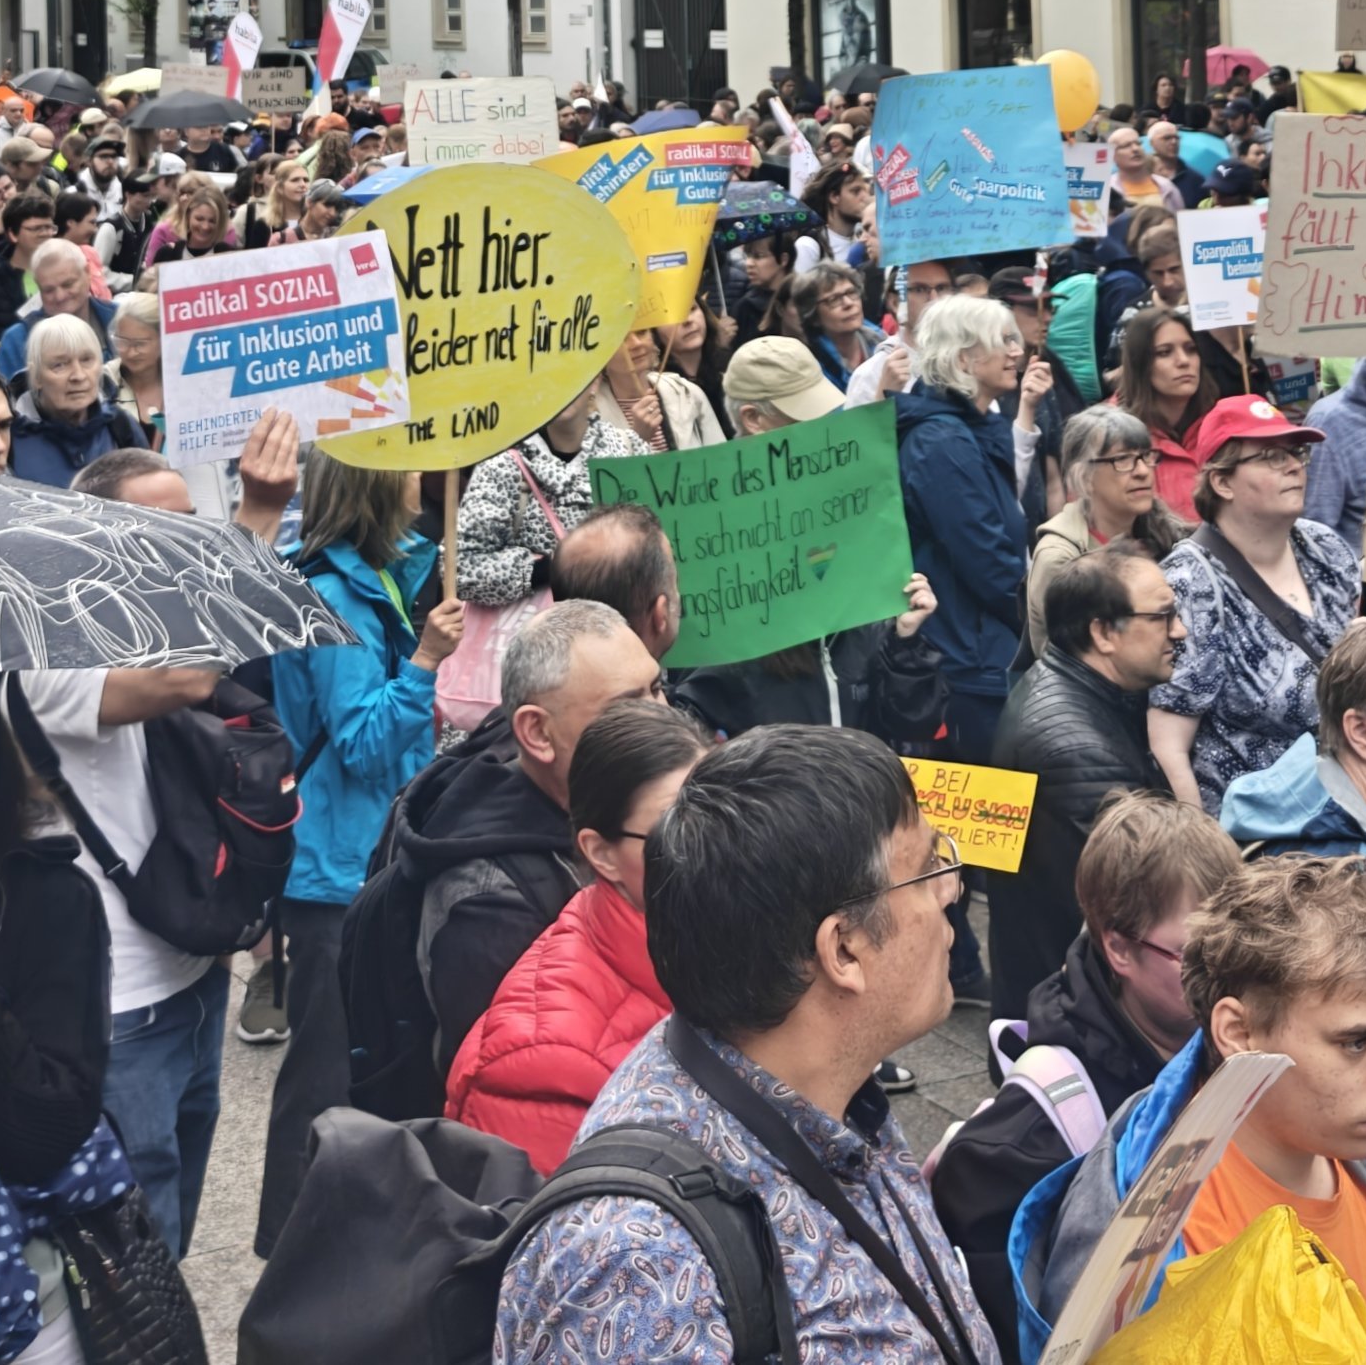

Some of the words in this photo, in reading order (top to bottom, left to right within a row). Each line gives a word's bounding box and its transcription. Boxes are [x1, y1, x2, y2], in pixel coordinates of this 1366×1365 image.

[259, 84, 283, 92] ALLE
[270, 70, 293, 79] SIND
[411, 89, 476, 125] ALLE
[486, 93, 527, 120] sind
[424, 136, 487, 163] immer
[493, 134, 545, 156] dabei
[667, 143, 717, 161] radikal
[719, 144, 750, 160] SOZIAL
[653, 171, 675, 185] für
[685, 186, 717, 200] Gute
[1280, 202, 1358, 260] fällt
[366, 204, 465, 300] Nett
[478, 205, 554, 294] hier.
[1195, 242, 1250, 262] Sparpolitik
[168, 285, 248, 323] radikal
[254, 273, 333, 309] SOZIAL
[195, 337, 232, 364] für
[239, 321, 338, 357] Inklusion
[344, 306, 383, 336] und
[405, 307, 479, 378] leider
[485, 303, 520, 363] net
[528, 298, 557, 373] für
[559, 293, 600, 353] alle
[246, 359, 301, 385] Gute
[306, 340, 372, 376] Arbeit
[1284, 377, 1307, 389] und
[179, 408, 262, 436] BEHINDERTEN
[404, 417, 436, 445] THE
[451, 401, 500, 438] LÄND
[179, 433, 218, 452] HILFE
[597, 467, 638, 505] Die
[645, 459, 719, 508] Würde
[732, 450, 764, 497] des
[767, 427, 860, 487] Menschen
[695, 511, 734, 559] sich
[739, 498, 785, 551] nicht
[790, 507, 815, 538] an
[822, 486, 873, 527] seiner
[933, 768, 971, 794] BEI
